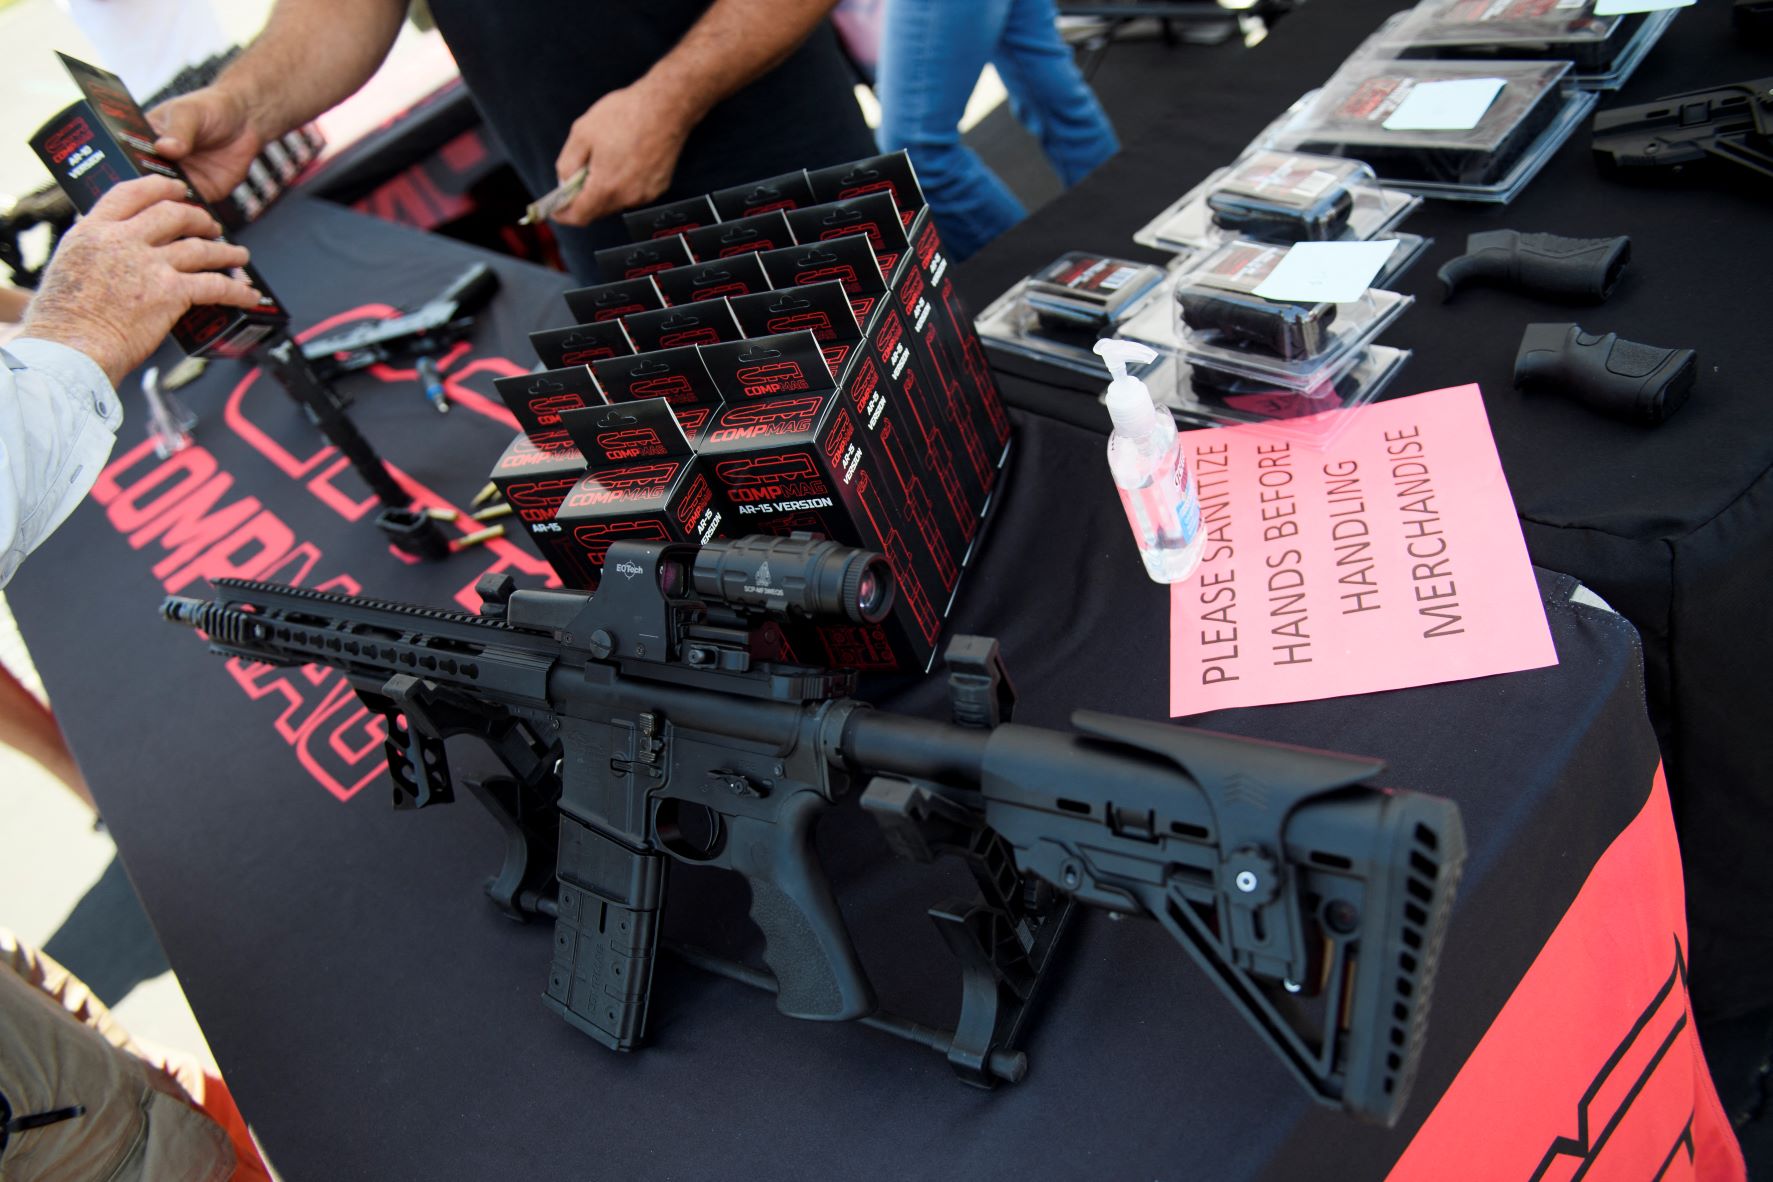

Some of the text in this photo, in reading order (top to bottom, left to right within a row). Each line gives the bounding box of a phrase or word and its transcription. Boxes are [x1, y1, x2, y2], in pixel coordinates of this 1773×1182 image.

[744, 379, 809, 397] COMPMAG
[867, 390, 880, 416] AR-15
[868, 396, 886, 430] VERSION
[710, 419, 812, 443] COMPMAG
[842, 442, 855, 469] AR-15
[843, 448, 862, 484] VERSION
[568, 486, 665, 508] COMPMAG
[728, 480, 828, 502] COMPMAG
[1257, 442, 1298, 541] BEFORE
[739, 497, 834, 515] AR-15 VERSION
[697, 508, 713, 536] AR-15
[1384, 424, 1466, 639] MERCHANDISE
[1323, 459, 1381, 615] HANDLING
[1196, 442, 1240, 685] PLEASE SANITIZE
[1265, 548, 1312, 666] HANDS
